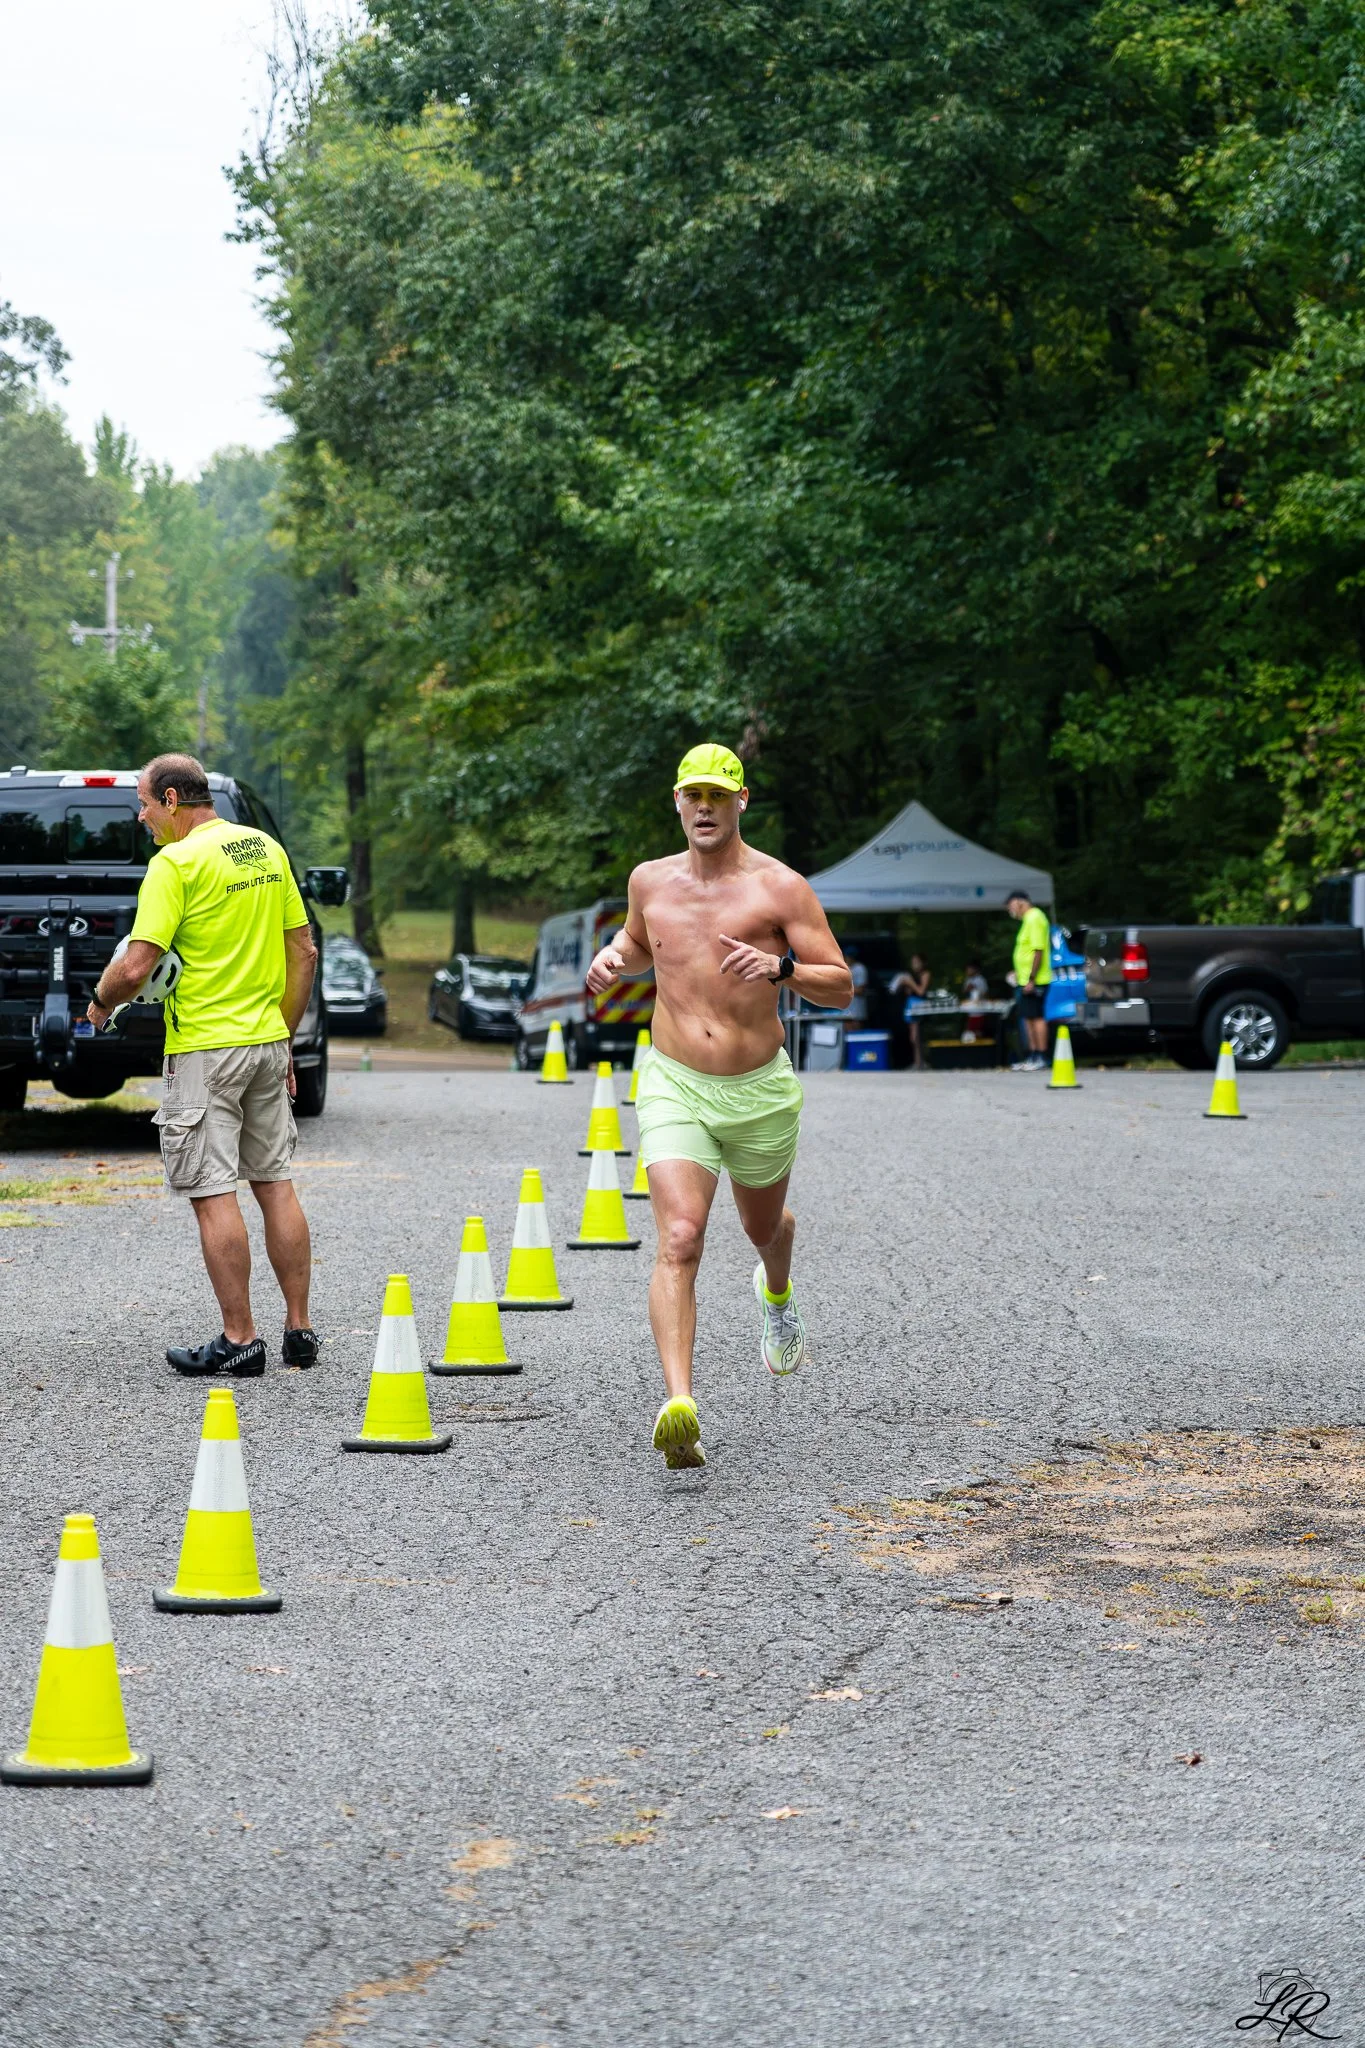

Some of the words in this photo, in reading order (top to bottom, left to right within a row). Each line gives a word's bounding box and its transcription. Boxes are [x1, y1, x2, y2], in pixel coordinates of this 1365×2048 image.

[221, 836, 266, 856] MEMPHIS
[231, 848, 267, 864] RUNNERS
[226, 880, 250, 894] FINISH
[53, 946, 64, 981] THULE
